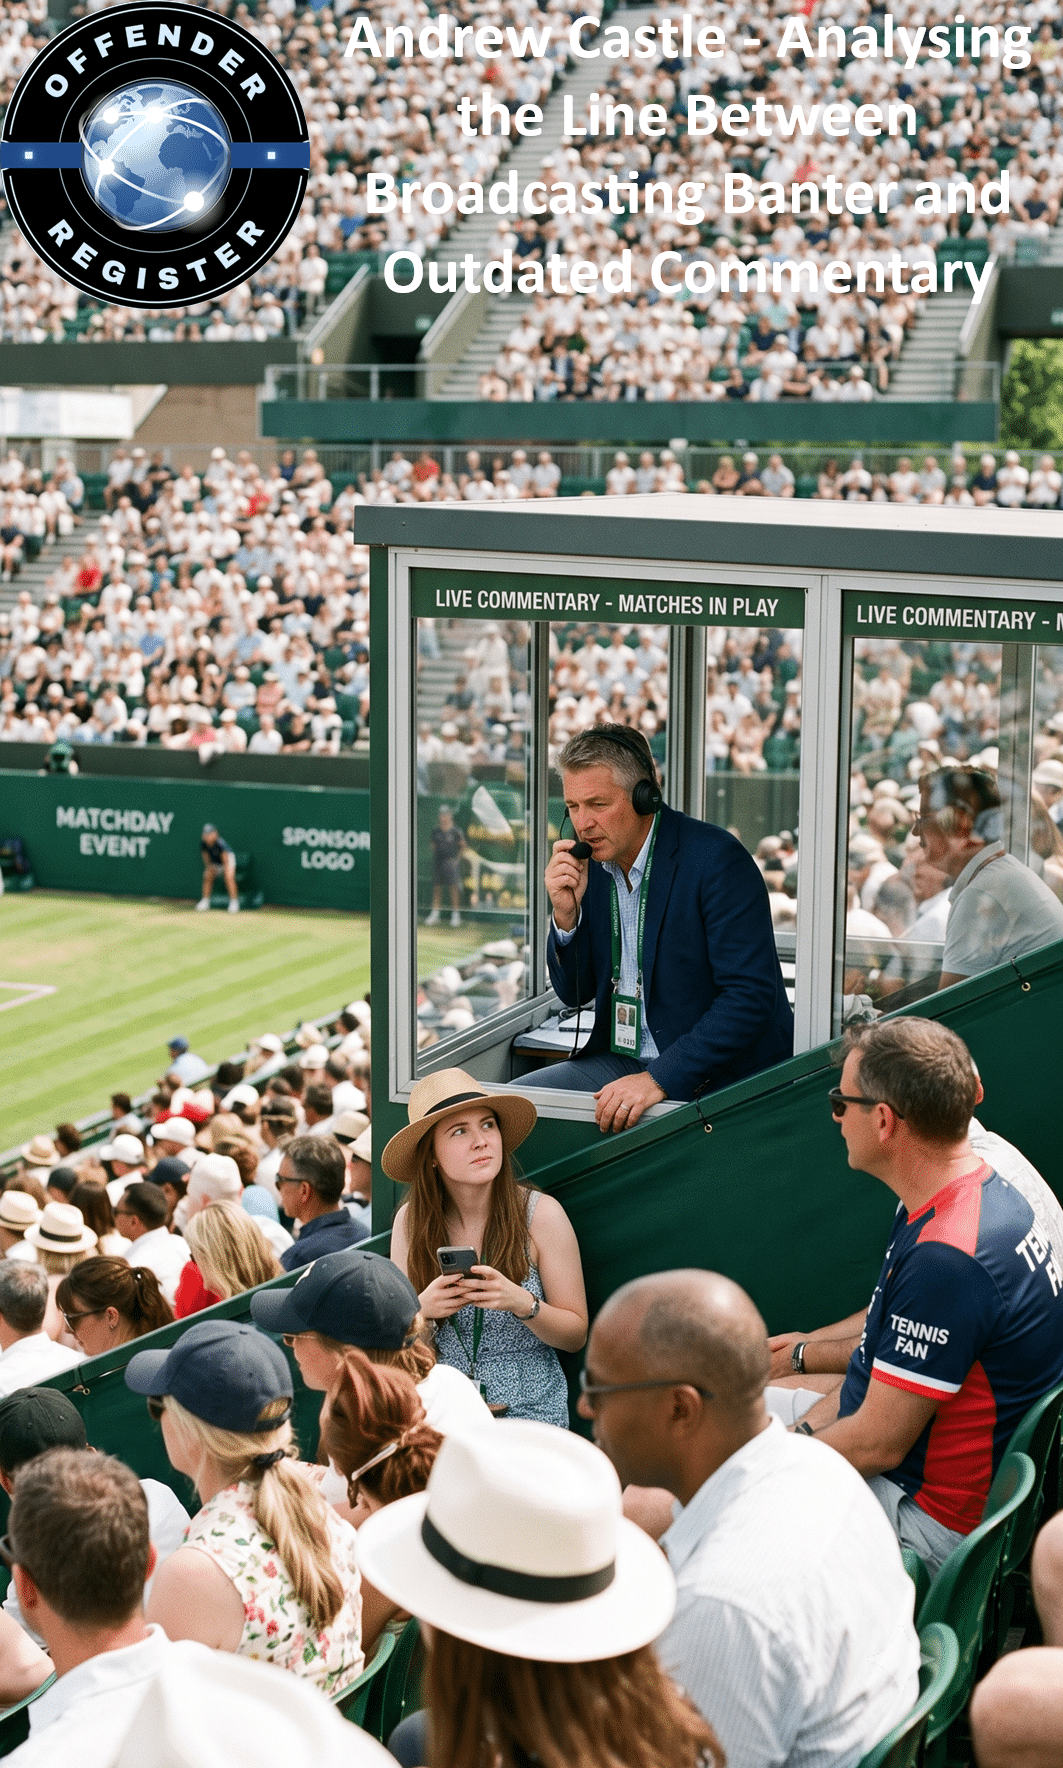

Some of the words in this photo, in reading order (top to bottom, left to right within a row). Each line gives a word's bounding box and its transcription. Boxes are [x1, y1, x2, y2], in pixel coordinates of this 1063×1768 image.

[435, 588, 472, 608] LIVE
[476, 589, 600, 612] COMMENTARY
[618, 593, 703, 615] MATCHES
[709, 595, 727, 616] IN
[732, 597, 779, 618] PLAY
[856, 604, 896, 624] LIVE
[902, 606, 1036, 630] COMMENTARY
[56, 806, 174, 834] MATCHDAY
[79, 833, 151, 858] EVENT
[301, 850, 355, 872] LOGO
[890, 1314, 950, 1344] TENNIS
[894, 1335, 929, 1360] FAN
